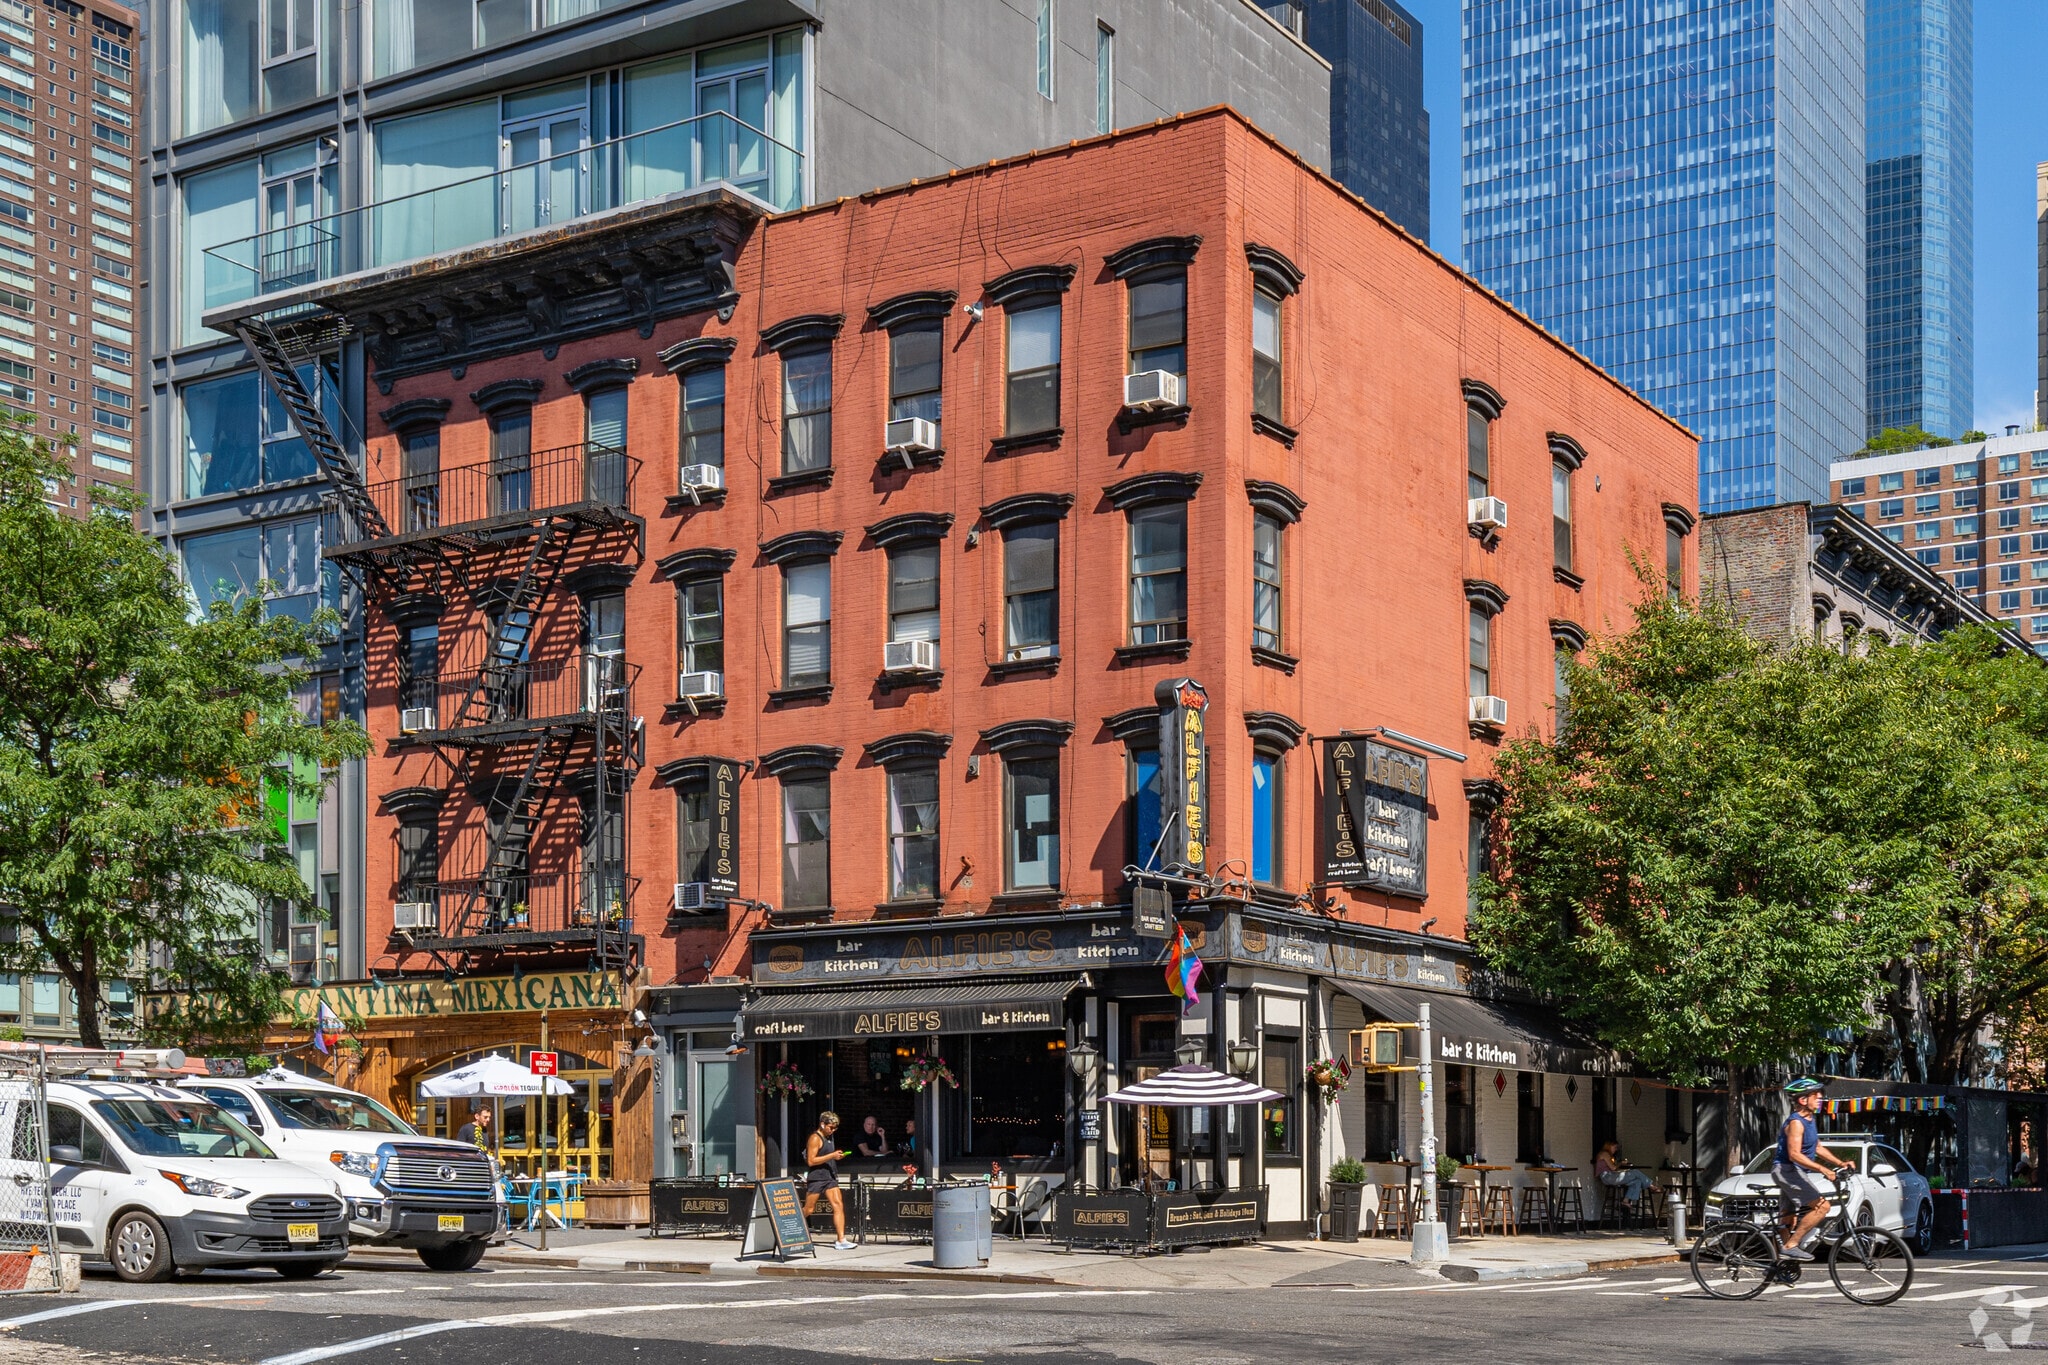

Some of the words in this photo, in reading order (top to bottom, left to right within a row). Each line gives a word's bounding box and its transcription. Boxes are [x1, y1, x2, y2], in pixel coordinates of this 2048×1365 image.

[1366, 752, 1421, 795] LFIE'S
[1333, 741, 1355, 857] ALFIE'S
[1378, 800, 1399, 819] bar
[716, 764, 733, 874] ALFIE'S
[1367, 825, 1408, 848] kitchen
[1366, 857, 1388, 872] aft
[1389, 857, 1416, 878] beer
[1091, 923, 1121, 937] bar
[1288, 926, 1305, 941] bar
[836, 939, 863, 953] bar
[900, 929, 1055, 970] ALFIE'S
[1077, 945, 1139, 959] kitchen
[1280, 947, 1314, 963] kitchen
[1324, 936, 1409, 978] ALFIE'S
[824, 959, 879, 973] kitchen
[1417, 968, 1445, 983] kitchen
[294, 983, 439, 1018] CANTINA
[451, 974, 621, 1013] MEXICANA
[854, 1011, 941, 1034] ALFIE'S
[981, 1012, 1001, 1024] bar
[1002, 1011, 1009, 1023] &
[1011, 1010, 1050, 1023] kitchen
[754, 1022, 779, 1035] craft
[781, 1021, 805, 1034] beer
[1441, 1037, 1462, 1057] bar
[1465, 1042, 1473, 1058] &
[1476, 1042, 1516, 1064] kitchen
[1582, 1058, 1607, 1072] craft
[1609, 1058, 1632, 1073] beer
[70, 1187, 81, 1197] LLC
[57, 1200, 76, 1210] PLACE
[684, 1200, 726, 1212] ALFIE'S
[901, 1204, 934, 1215] ALFIE
[779, 1209, 796, 1217] HOUR
[1076, 1212, 1127, 1223] ALFIE'S
[1169, 1211, 1189, 1222] Brunch
[1214, 1209, 1219, 1218] &
[1220, 1208, 1241, 1218] Holidays
